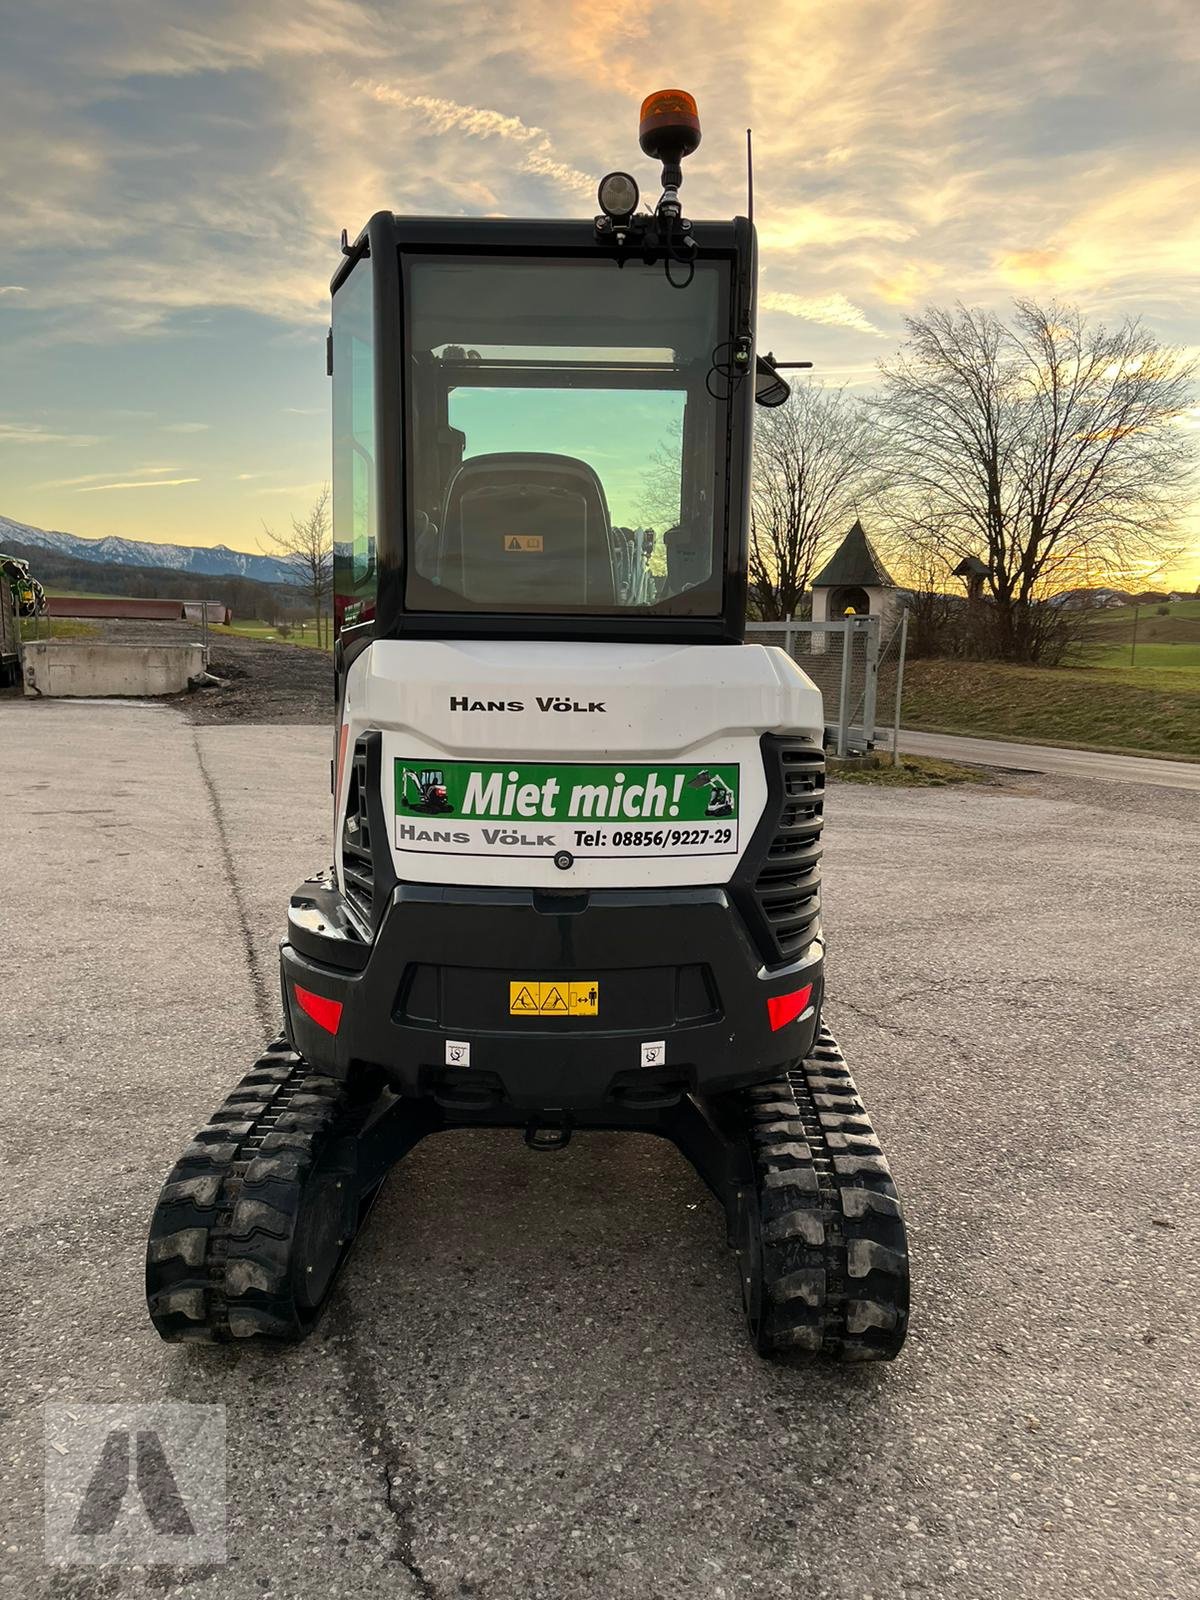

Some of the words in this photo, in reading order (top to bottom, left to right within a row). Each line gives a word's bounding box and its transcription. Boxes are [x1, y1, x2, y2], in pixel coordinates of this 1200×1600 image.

[461, 771, 560, 817] Miet
[568, 772, 685, 817] mich!
[574, 830, 607, 846] Tel:
[612, 829, 732, 848] 08856/9227-29
